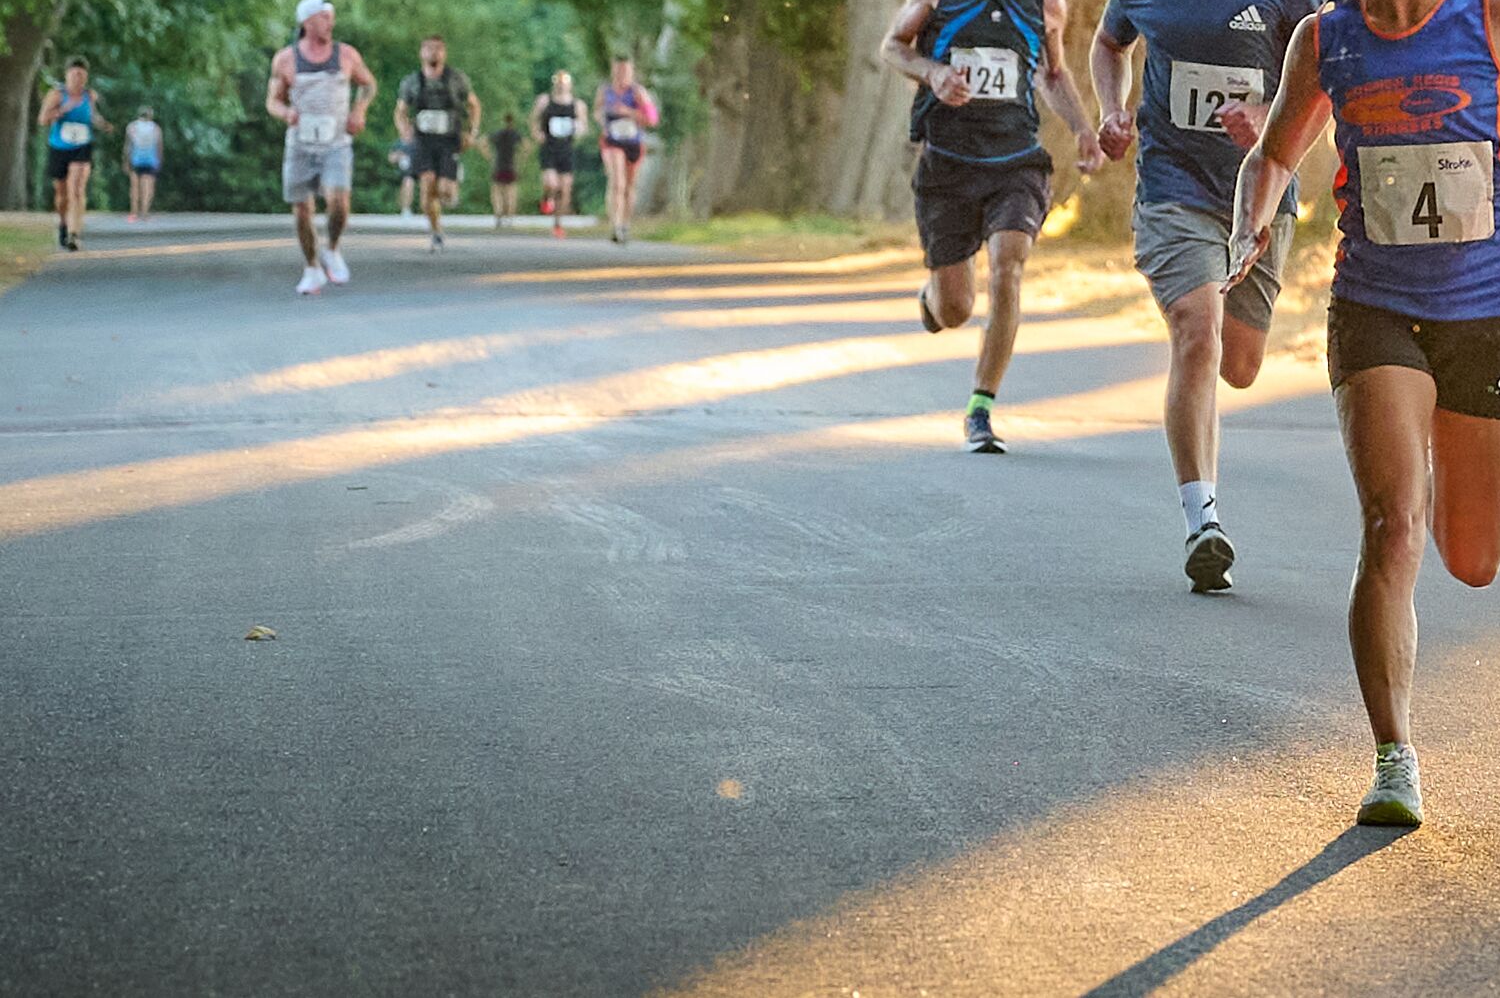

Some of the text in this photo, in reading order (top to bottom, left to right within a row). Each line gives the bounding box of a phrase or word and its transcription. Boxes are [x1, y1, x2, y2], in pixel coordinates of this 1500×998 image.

[1229, 20, 1267, 32] adidas
[965, 65, 1005, 95] 124
[1437, 156, 1474, 171] Stroke
[1411, 181, 1444, 239] 4
